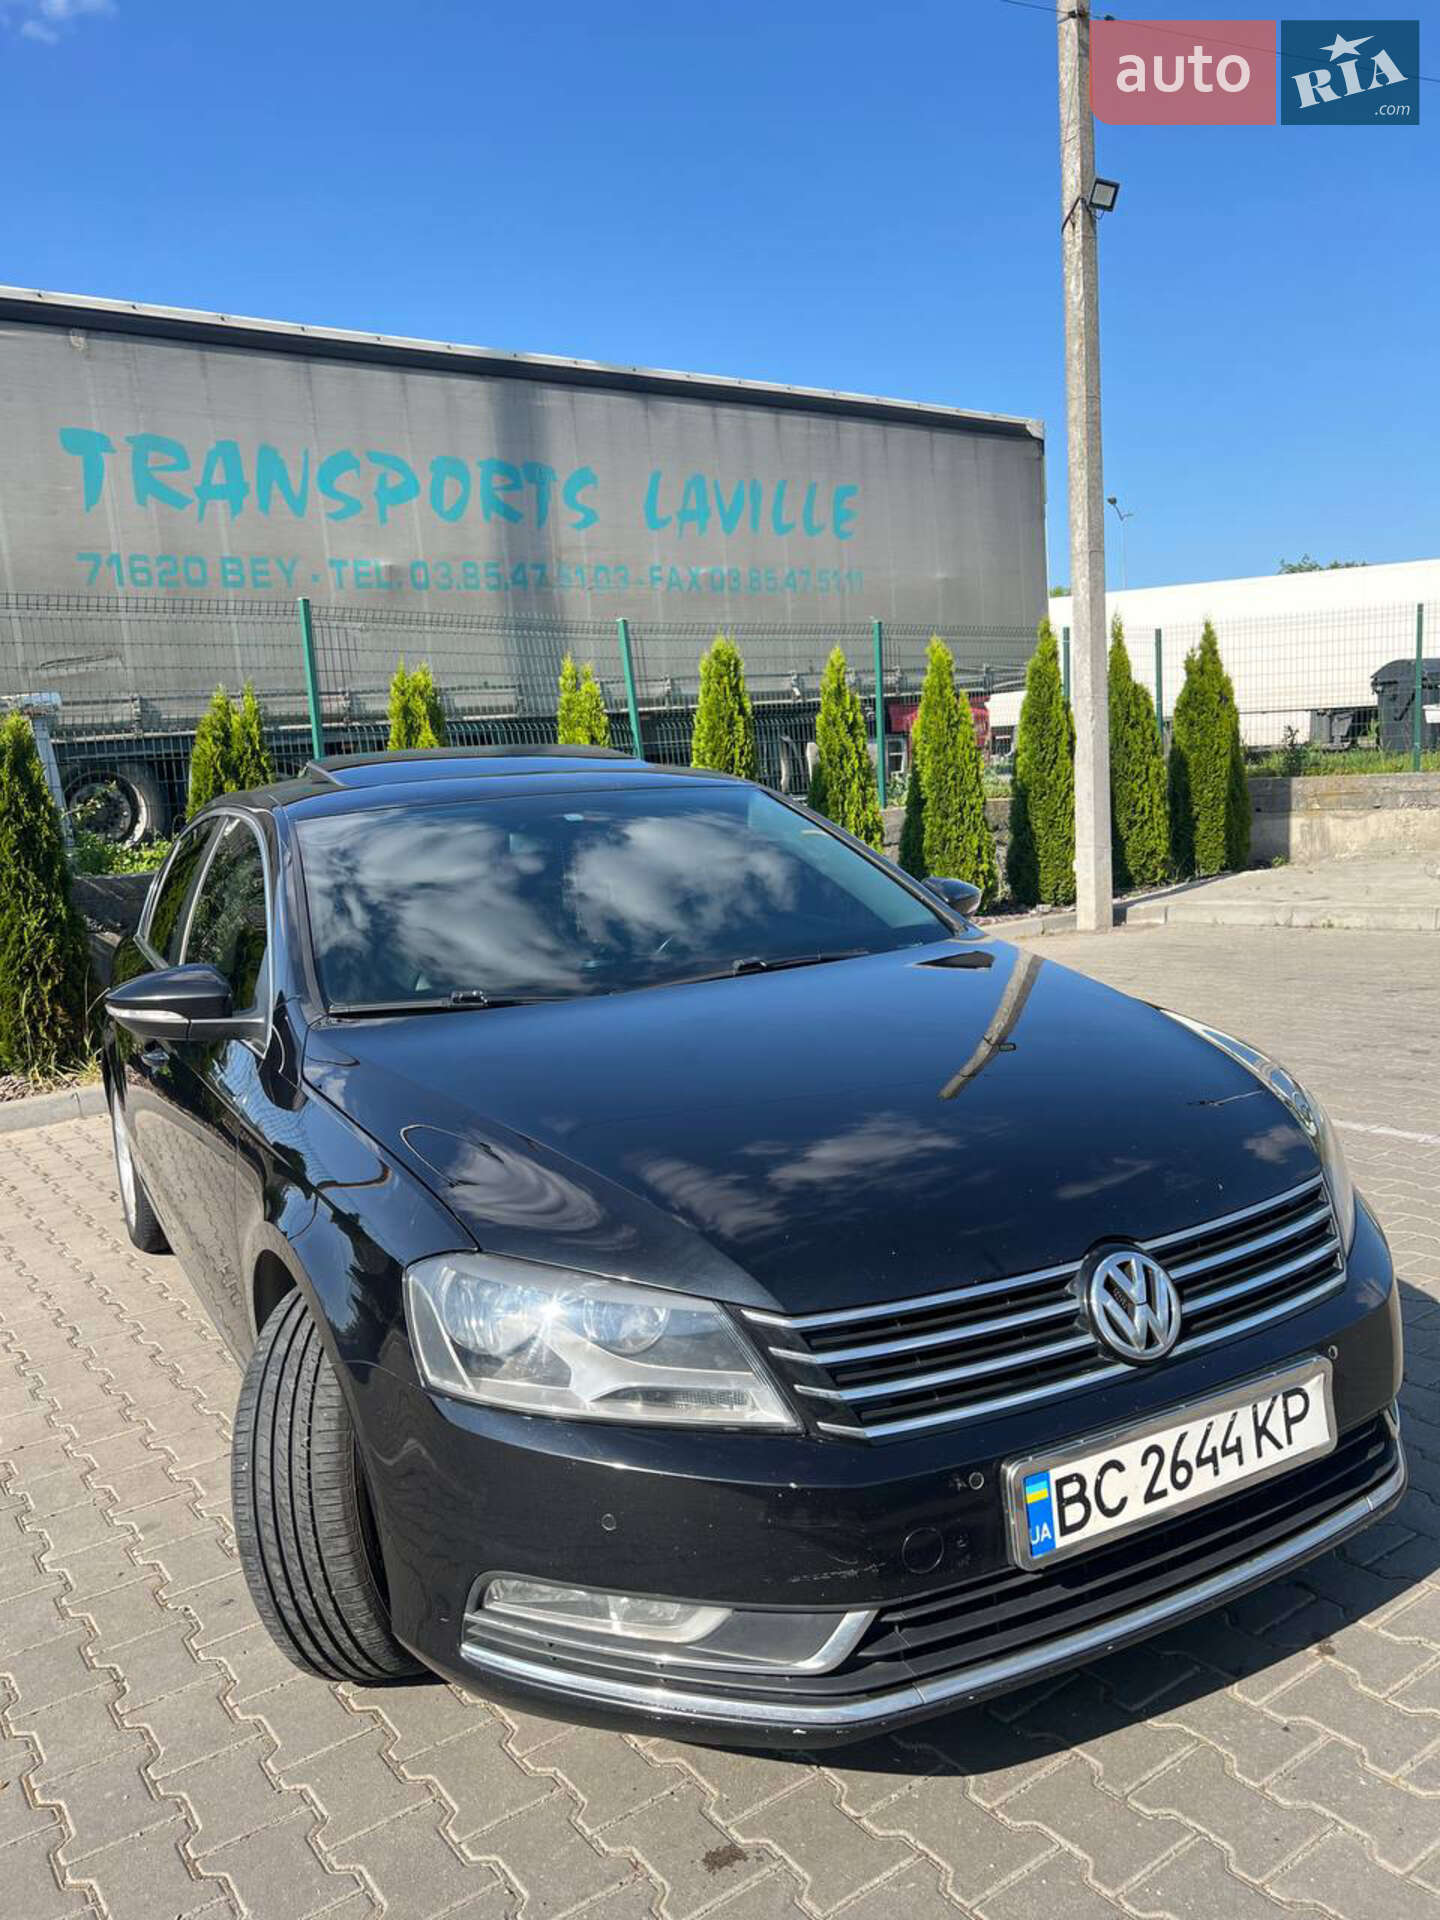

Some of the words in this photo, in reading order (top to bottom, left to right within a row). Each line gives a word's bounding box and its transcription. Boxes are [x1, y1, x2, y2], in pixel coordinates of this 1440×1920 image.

[59, 427, 599, 531] TRANSPORTS
[643, 469, 859, 540] LAVILLE
[76, 552, 208, 589] 71620
[220, 556, 299, 591] BEY
[649, 564, 699, 592] FAX
[1054, 1459, 1129, 1538] BC
[1140, 1411, 1244, 1504] 2644
[1251, 1387, 1310, 1459] KP
